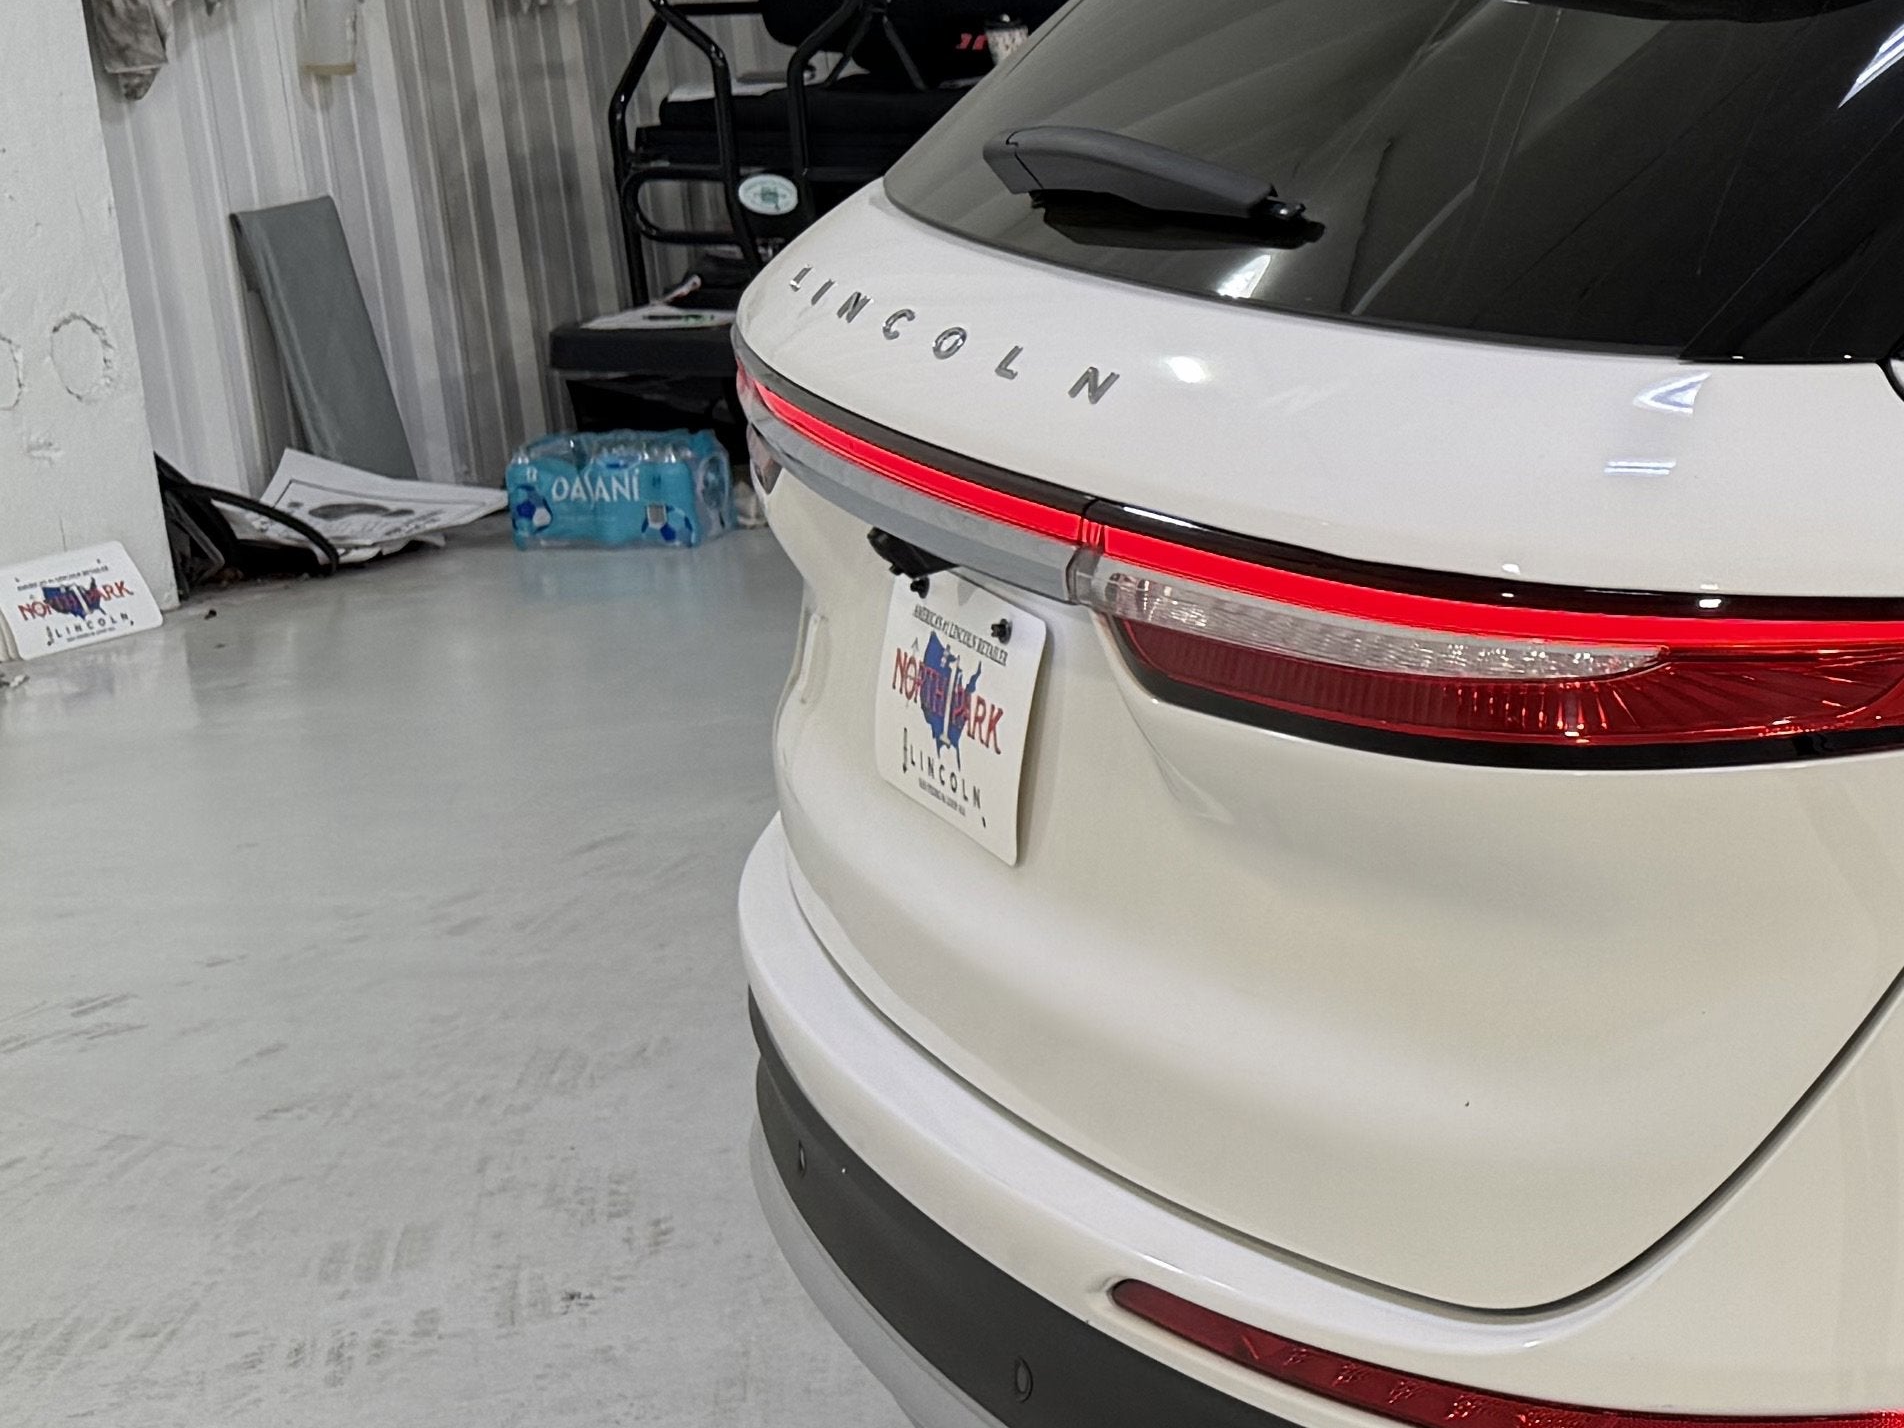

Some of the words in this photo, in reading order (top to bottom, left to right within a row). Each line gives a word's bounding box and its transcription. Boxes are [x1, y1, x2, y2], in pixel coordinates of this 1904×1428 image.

[789, 264, 1120, 404] LINCOLN
[552, 468, 640, 510] DASANI
[55, 612, 129, 639] LINCOLN
[910, 743, 982, 809] LINCOLN
